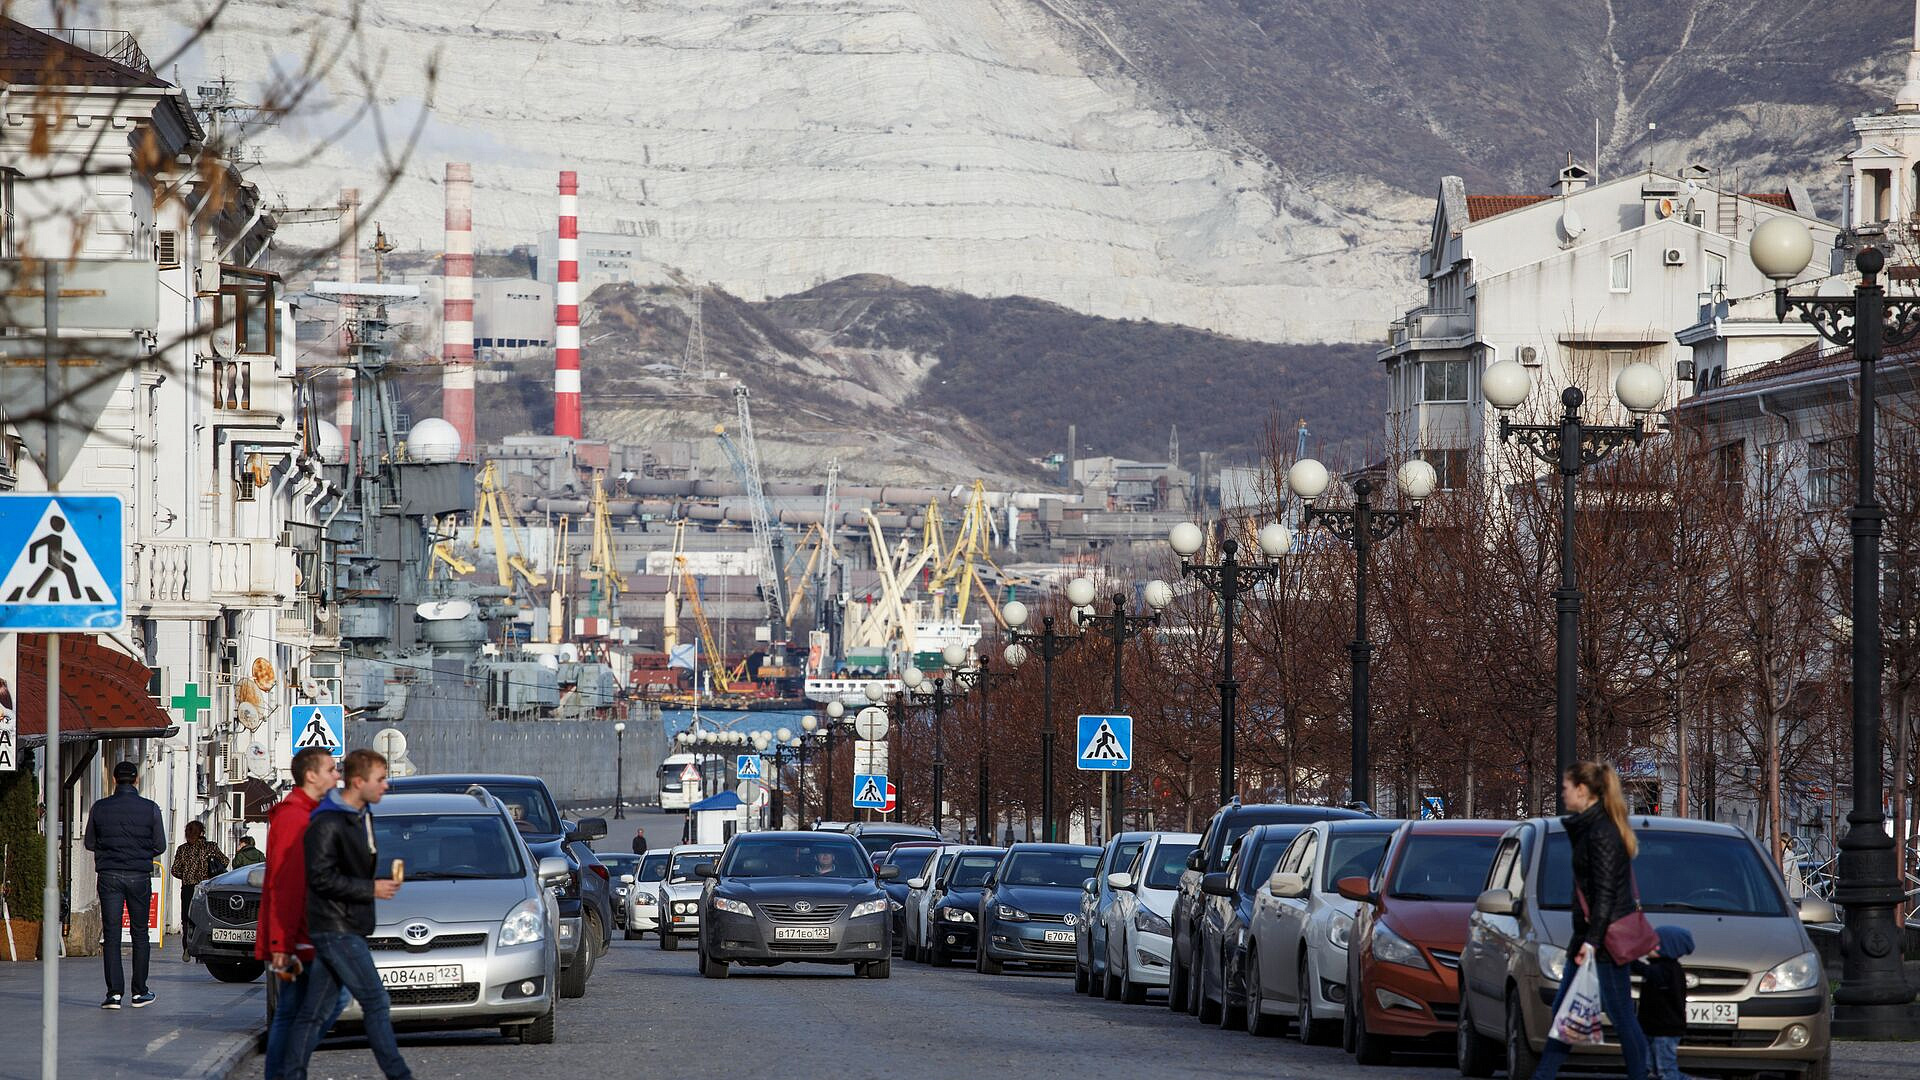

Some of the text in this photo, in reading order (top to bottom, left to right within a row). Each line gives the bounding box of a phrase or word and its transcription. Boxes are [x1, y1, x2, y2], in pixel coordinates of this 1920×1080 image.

[243, 931, 256, 939] 123
[438, 967, 459, 978] 123
[1715, 1004, 1732, 1017] 93
